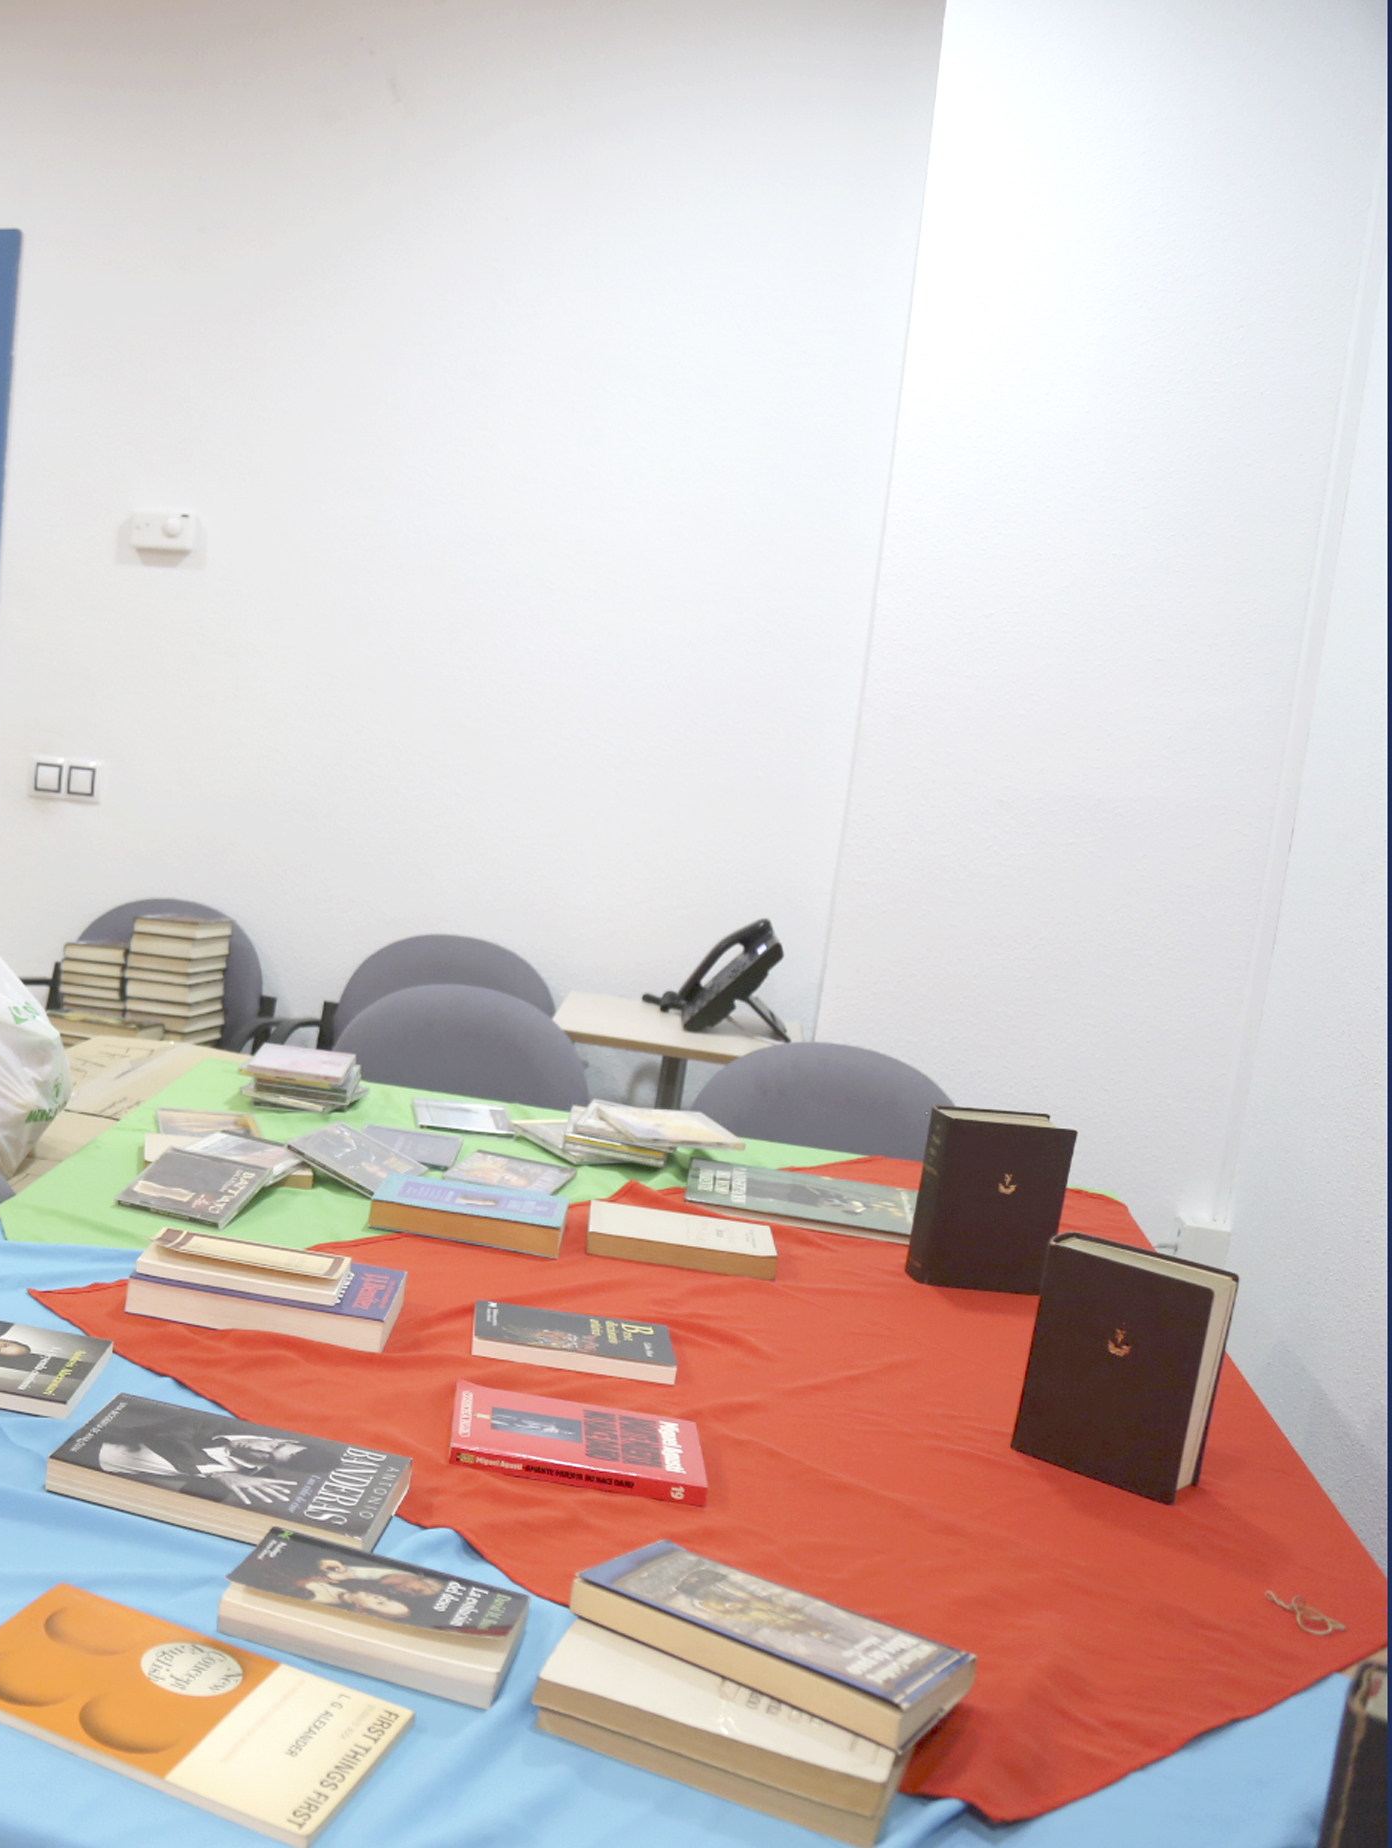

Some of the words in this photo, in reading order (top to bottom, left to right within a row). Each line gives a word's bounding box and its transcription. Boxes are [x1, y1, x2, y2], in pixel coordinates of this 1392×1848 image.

[304, 1447, 387, 1525] BANDERAS
[359, 1466, 400, 1520] ANTONIO
[671, 1486, 685, 1499] 19
[433, 1593, 460, 1612] deseo
[445, 1581, 466, 1596] del
[469, 1587, 489, 1598] La
[148, 1644, 205, 1681] English
[170, 1651, 227, 1690] Concept
[208, 1668, 243, 1693] New
[285, 1710, 334, 1758] ALEXANDER
[363, 1709, 400, 1744] FIRST
[319, 1743, 372, 1791] THINGS
[287, 1790, 330, 1830] FIRST
